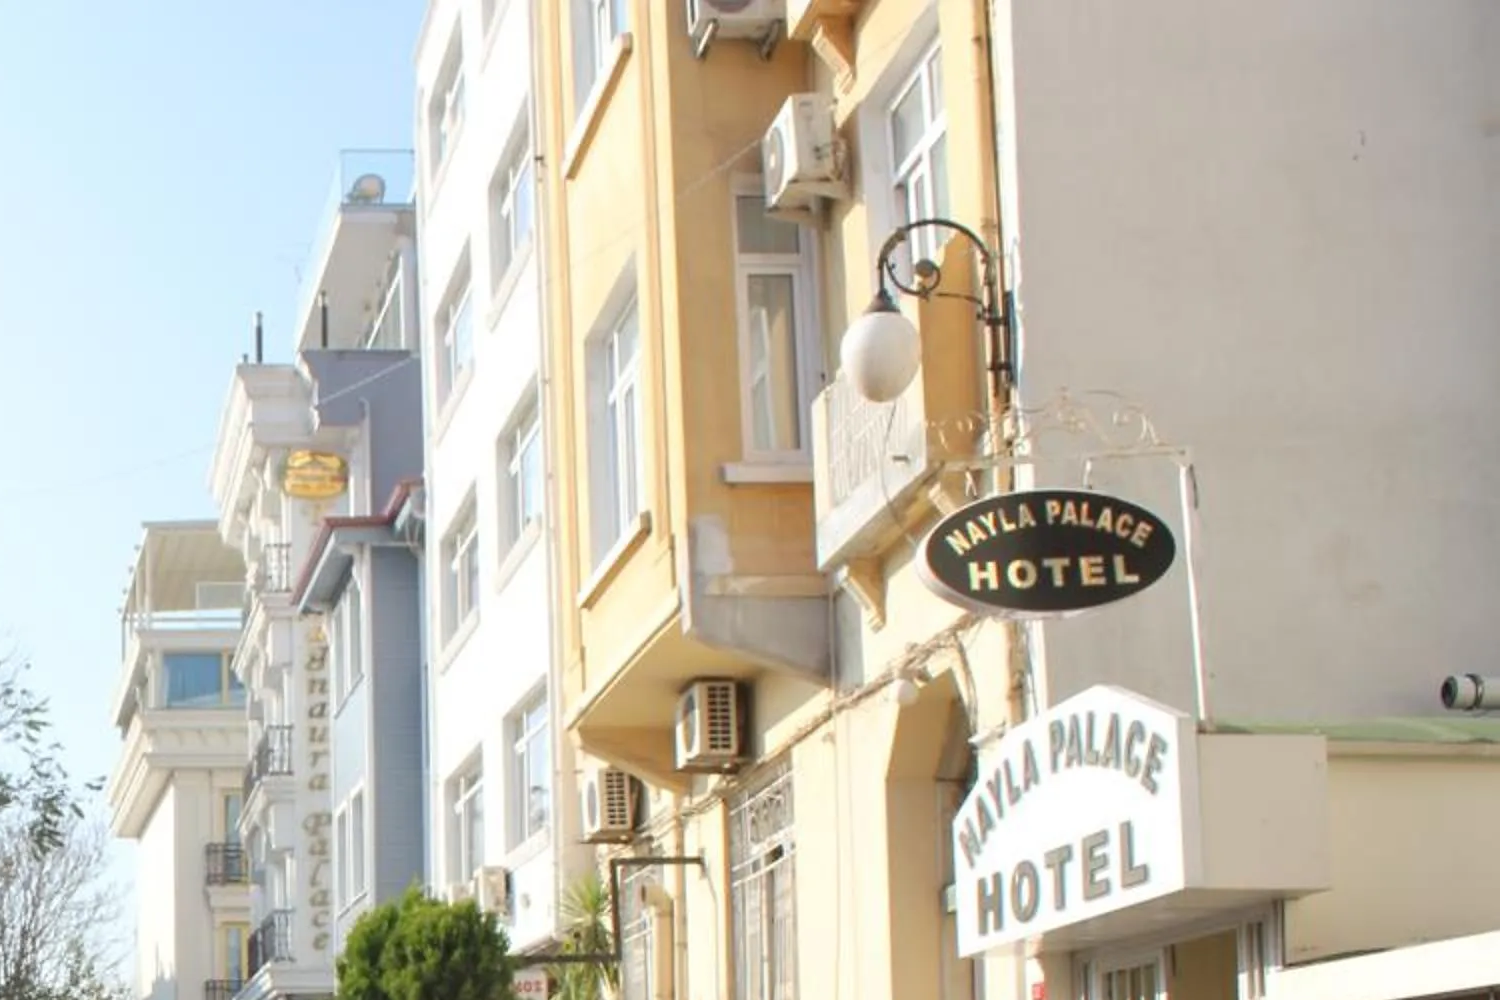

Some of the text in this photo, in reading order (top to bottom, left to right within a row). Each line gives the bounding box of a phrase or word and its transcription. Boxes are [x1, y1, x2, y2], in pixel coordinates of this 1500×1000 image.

[945, 499, 1153, 556] NAYLA PALACE
[968, 552, 1140, 591] HOTEL
[959, 710, 1168, 869] NAYLA PALACE
[977, 820, 1150, 936] HOTEL
